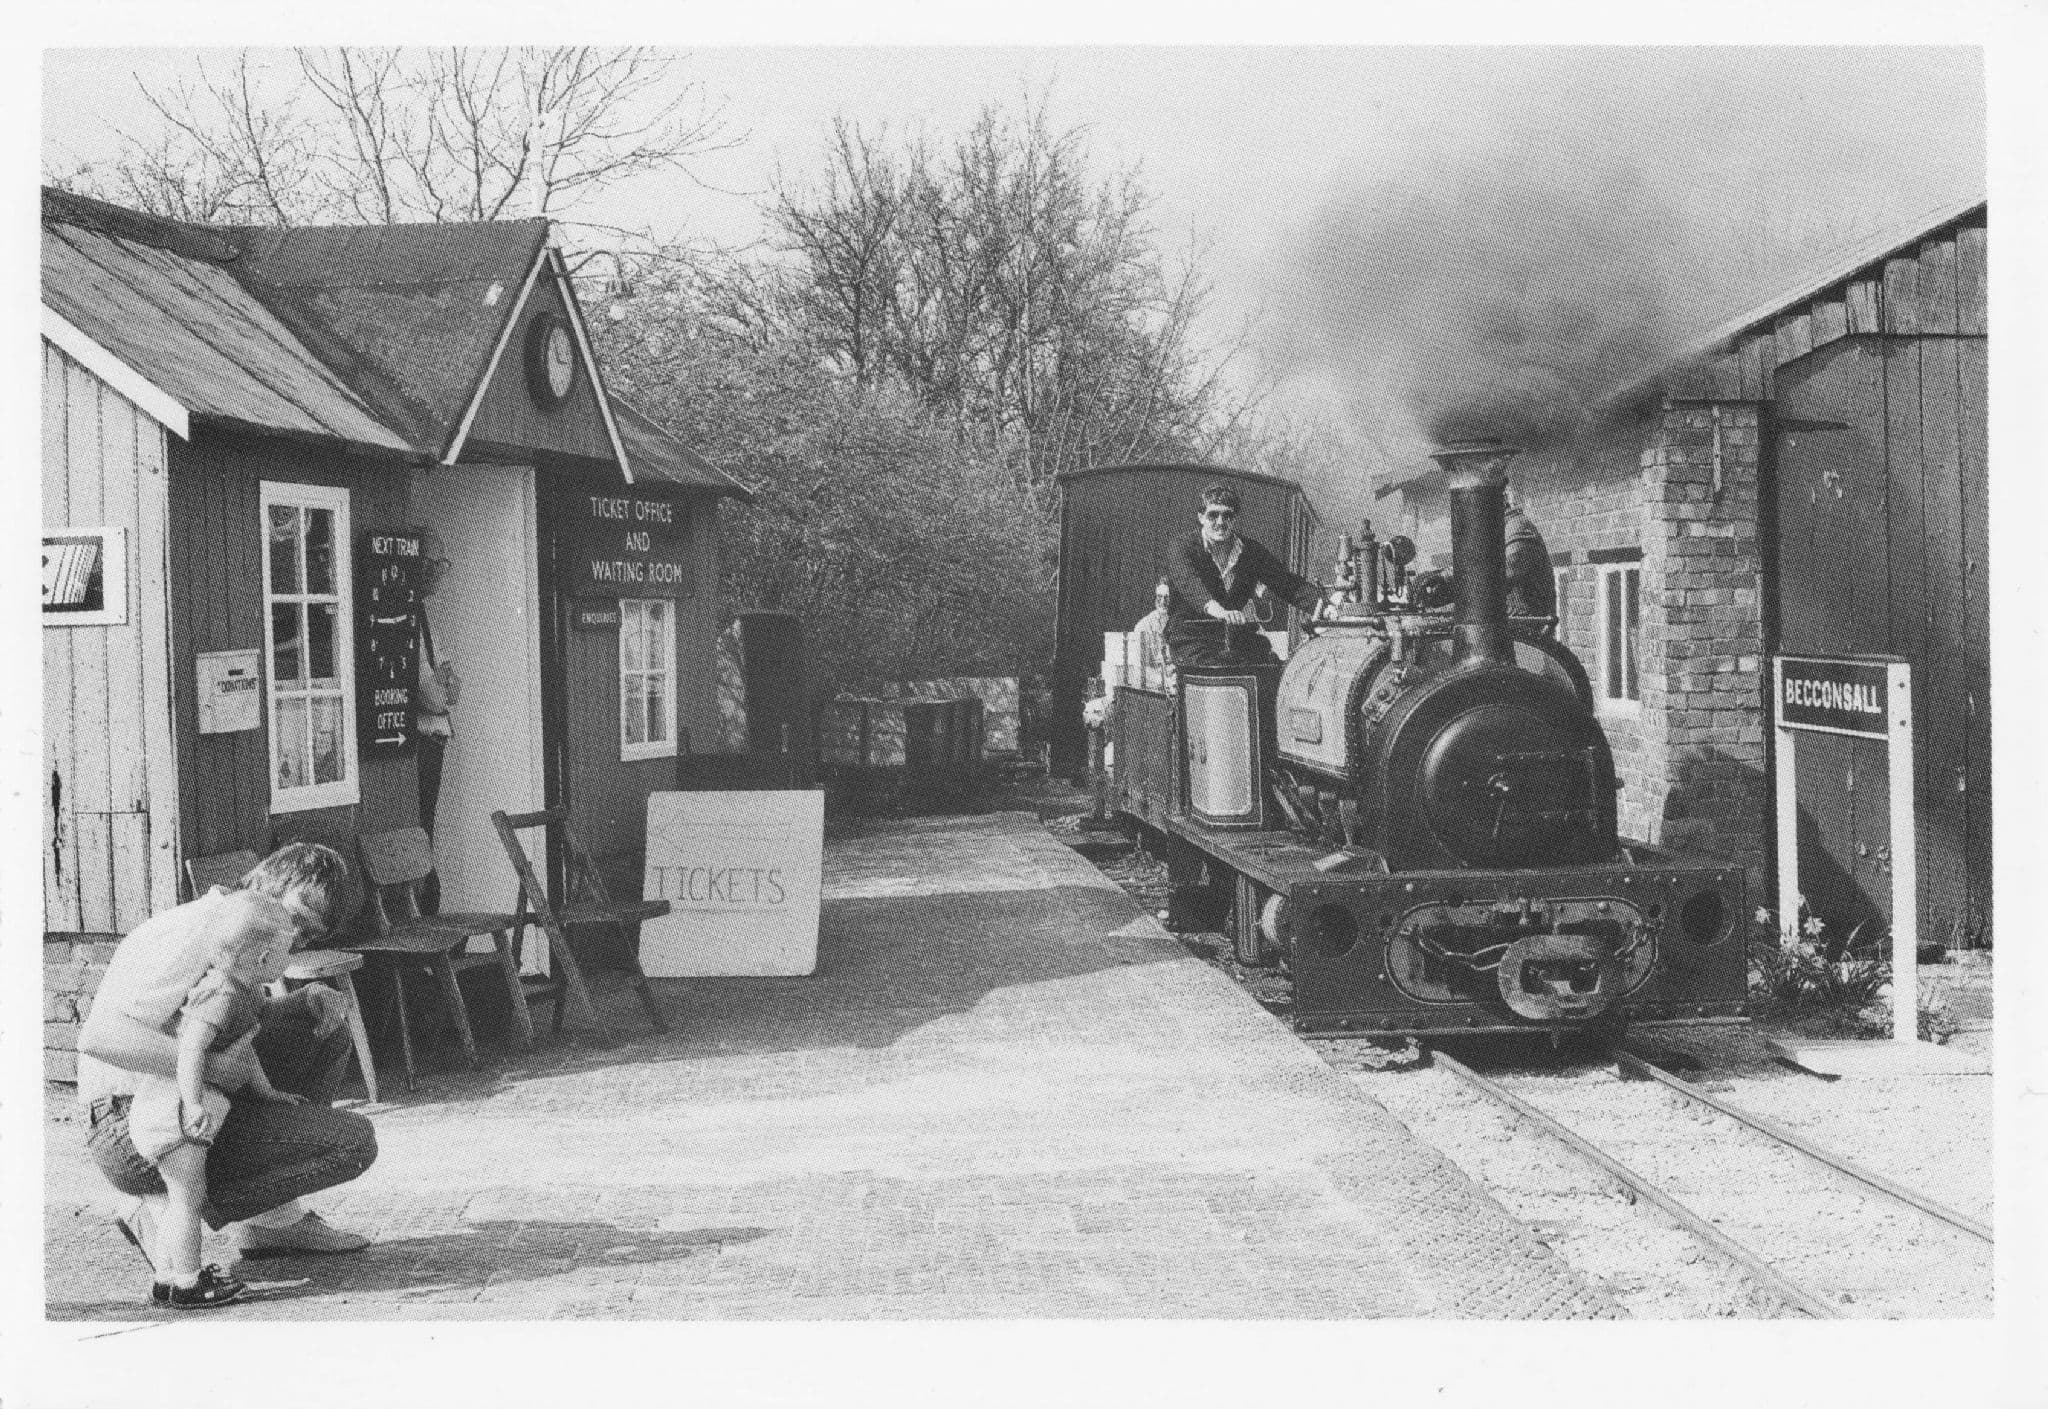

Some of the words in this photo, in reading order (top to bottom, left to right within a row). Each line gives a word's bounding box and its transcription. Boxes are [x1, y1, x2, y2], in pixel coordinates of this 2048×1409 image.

[590, 496, 629, 519] TICKET
[635, 500, 672, 523] OFFICE
[372, 536, 394, 555] NEXT
[396, 537, 419, 556] TRAIN
[626, 531, 650, 551] AND
[591, 560, 644, 582] WAITING
[648, 562, 682, 583] ROOM
[375, 688, 408, 706] BOOKING
[1785, 678, 1882, 714] BECCONSALL
[377, 711, 406, 730] OFFICE
[653, 866, 785, 904] TICKETS
